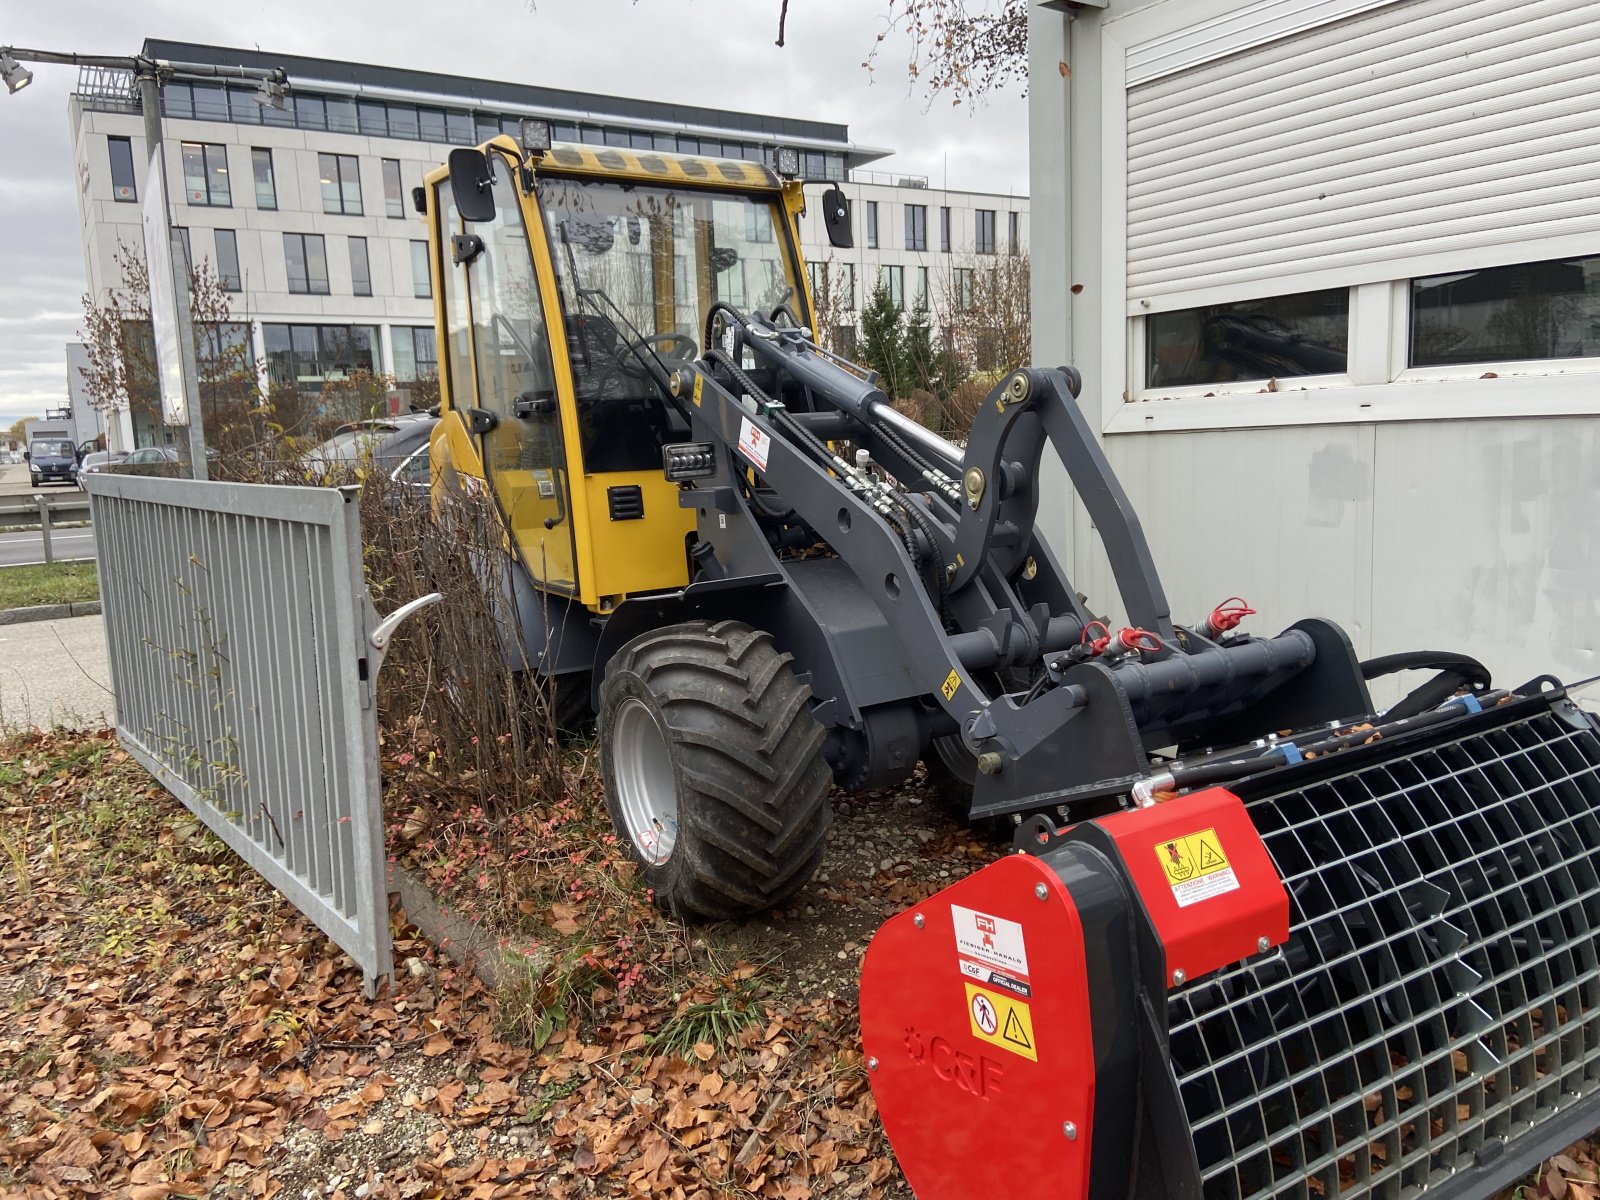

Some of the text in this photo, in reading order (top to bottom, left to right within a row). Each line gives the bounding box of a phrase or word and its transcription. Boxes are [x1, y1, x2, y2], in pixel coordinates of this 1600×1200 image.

[1174, 878, 1206, 892] ATTENZIONE
[1208, 869, 1231, 881] WARNING
[977, 917, 994, 931] FH
[993, 951, 1022, 964] HARALD
[967, 965, 980, 975] C&F
[992, 976, 1011, 988] OFFICIAL
[929, 1036, 1004, 1102] C&F
